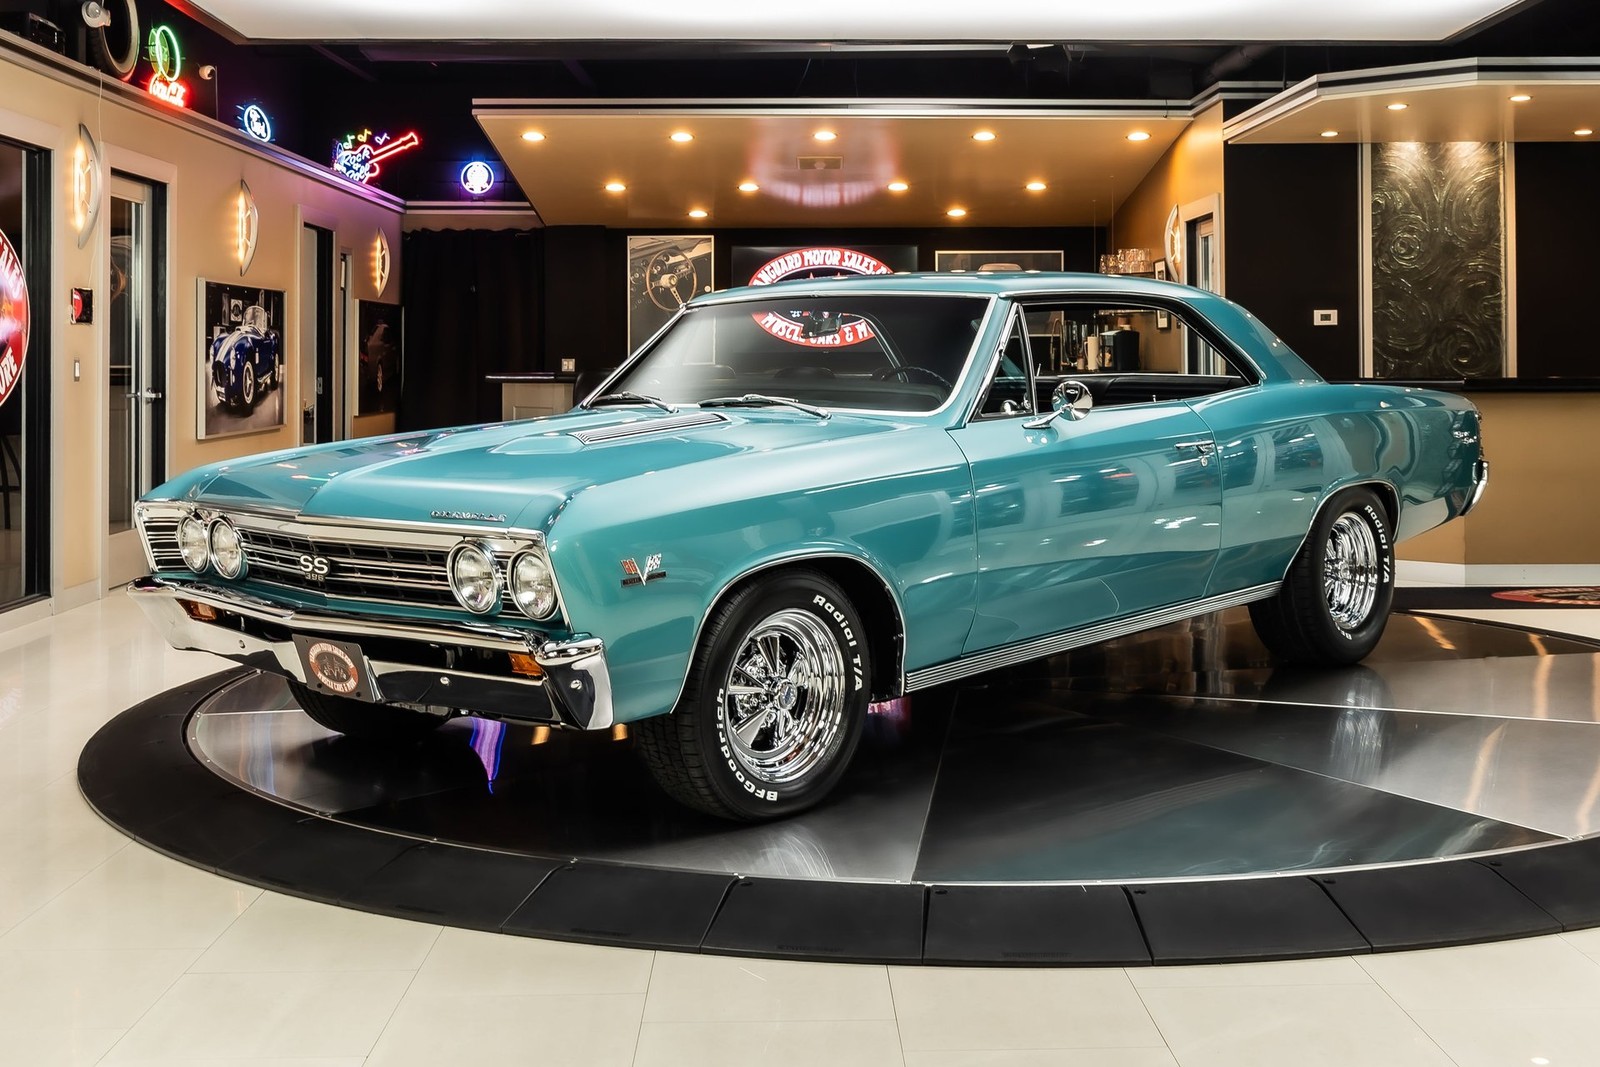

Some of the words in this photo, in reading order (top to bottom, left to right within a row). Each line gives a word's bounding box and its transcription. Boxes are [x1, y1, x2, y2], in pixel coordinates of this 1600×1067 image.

[0, 236, 24, 299] ALES
[804, 250, 841, 266] MOTOR
[844, 326, 854, 342] &
[1364, 504, 1388, 549] Radial
[300, 555, 329, 574] SS
[813, 594, 857, 647] Radial
[852, 653, 863, 691] T/A
[716, 688, 778, 801] BFGoodrich
